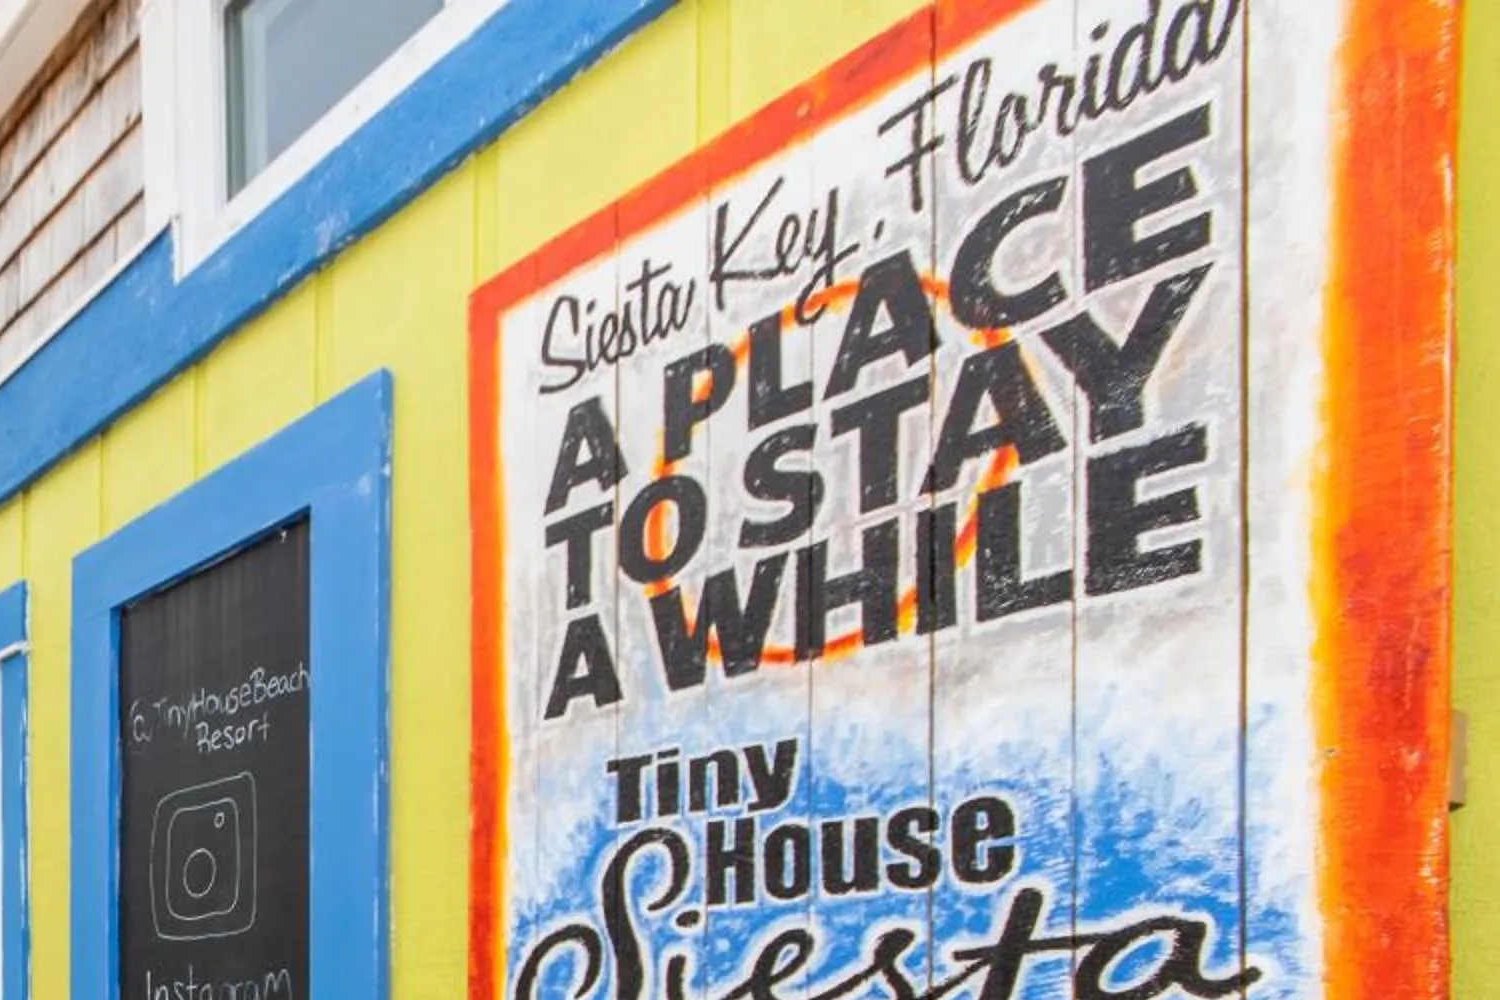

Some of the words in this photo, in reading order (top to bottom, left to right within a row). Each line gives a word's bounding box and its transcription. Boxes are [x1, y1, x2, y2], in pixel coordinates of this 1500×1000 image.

[538, 258, 695, 394] Siesta
[877, 0, 1242, 213] Florida
[544, 396, 627, 517] A
[662, 102, 1213, 466] PLACE
[543, 619, 622, 719] A
[649, 421, 1206, 694] WHILE
[544, 476, 707, 611] TO
[738, 261, 1214, 552] STAY
[195, 711, 271, 753] Resort
[606, 736, 799, 827] Tiny
[705, 795, 1017, 908] House
